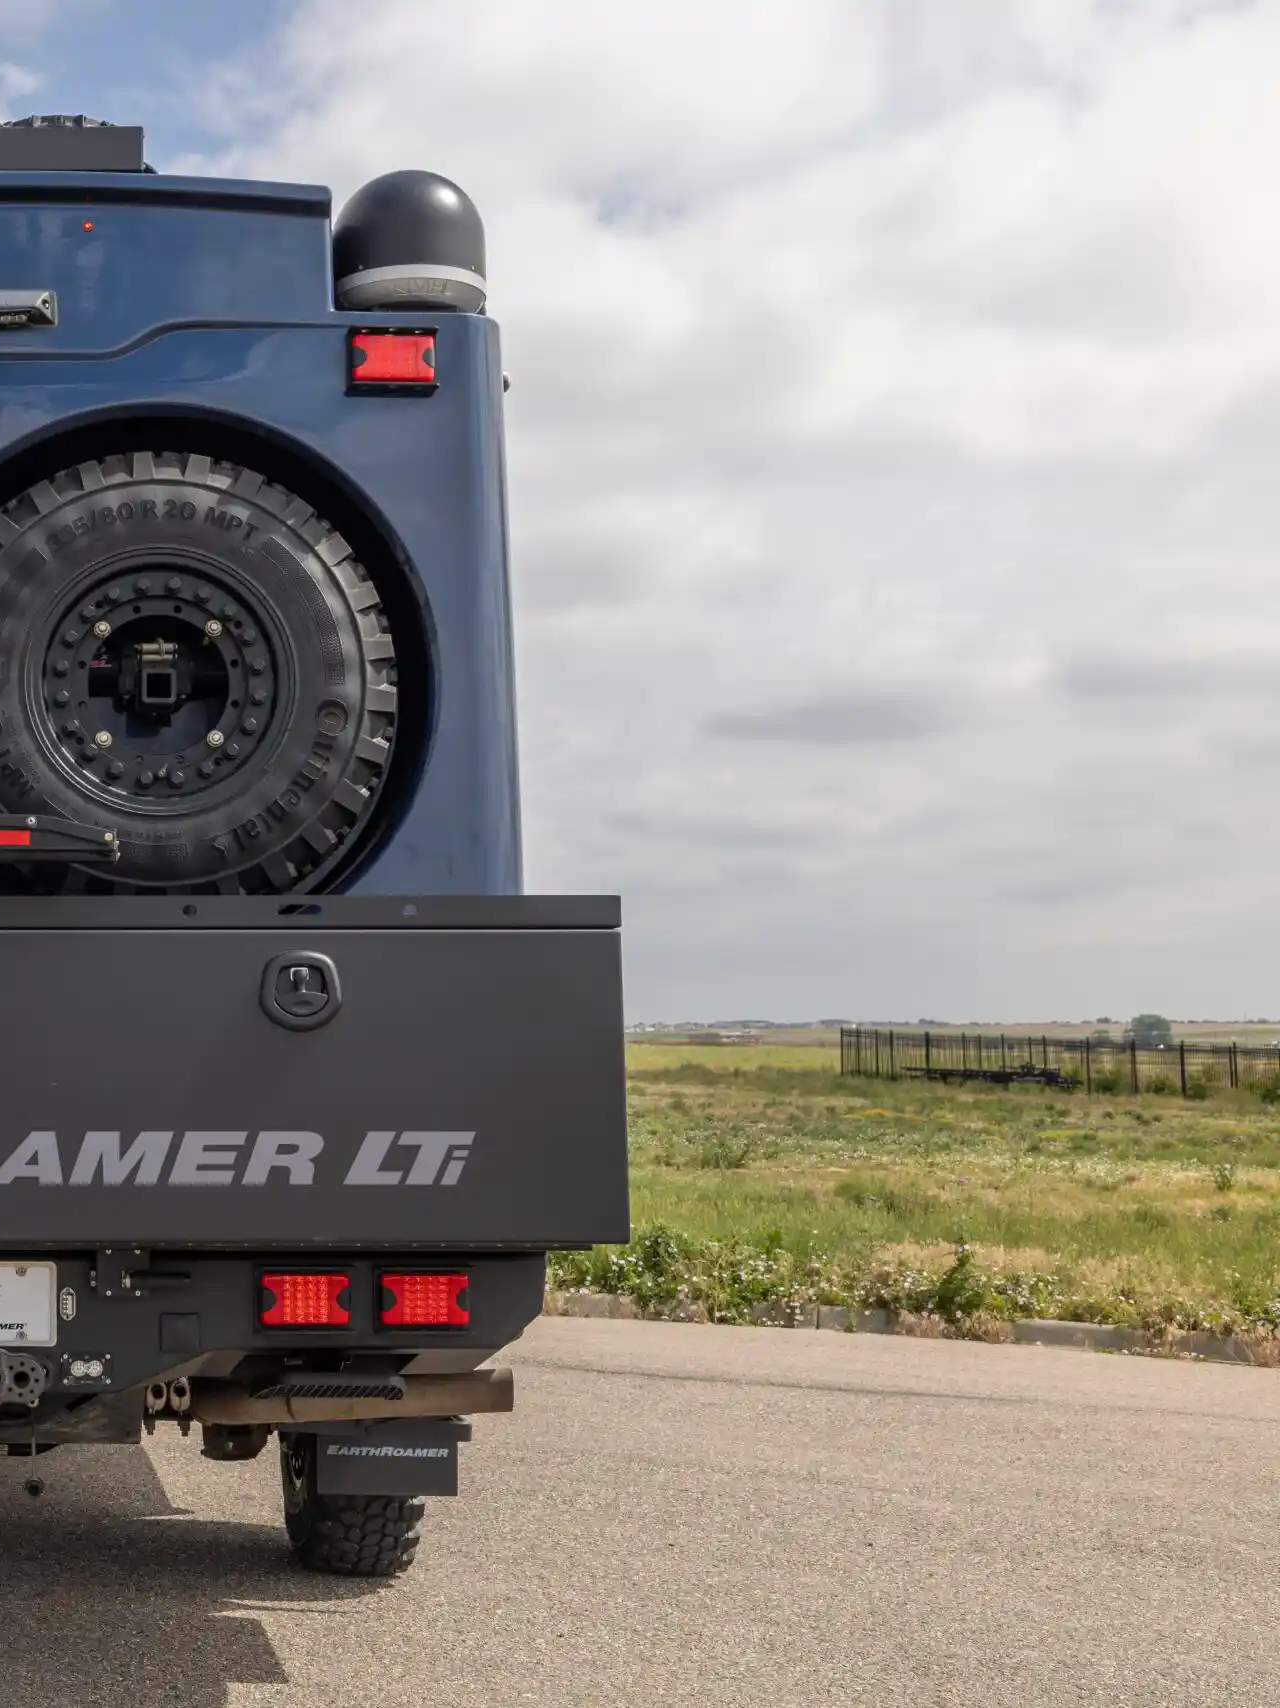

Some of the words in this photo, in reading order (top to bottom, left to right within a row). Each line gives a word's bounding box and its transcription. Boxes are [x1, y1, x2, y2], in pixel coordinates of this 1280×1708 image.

[142, 498, 159, 520] R
[163, 500, 197, 521] 20
[204, 506, 261, 542] MPT
[342, 1130, 478, 1186] LTi
[326, 1443, 450, 1459] EARTHROAMER
